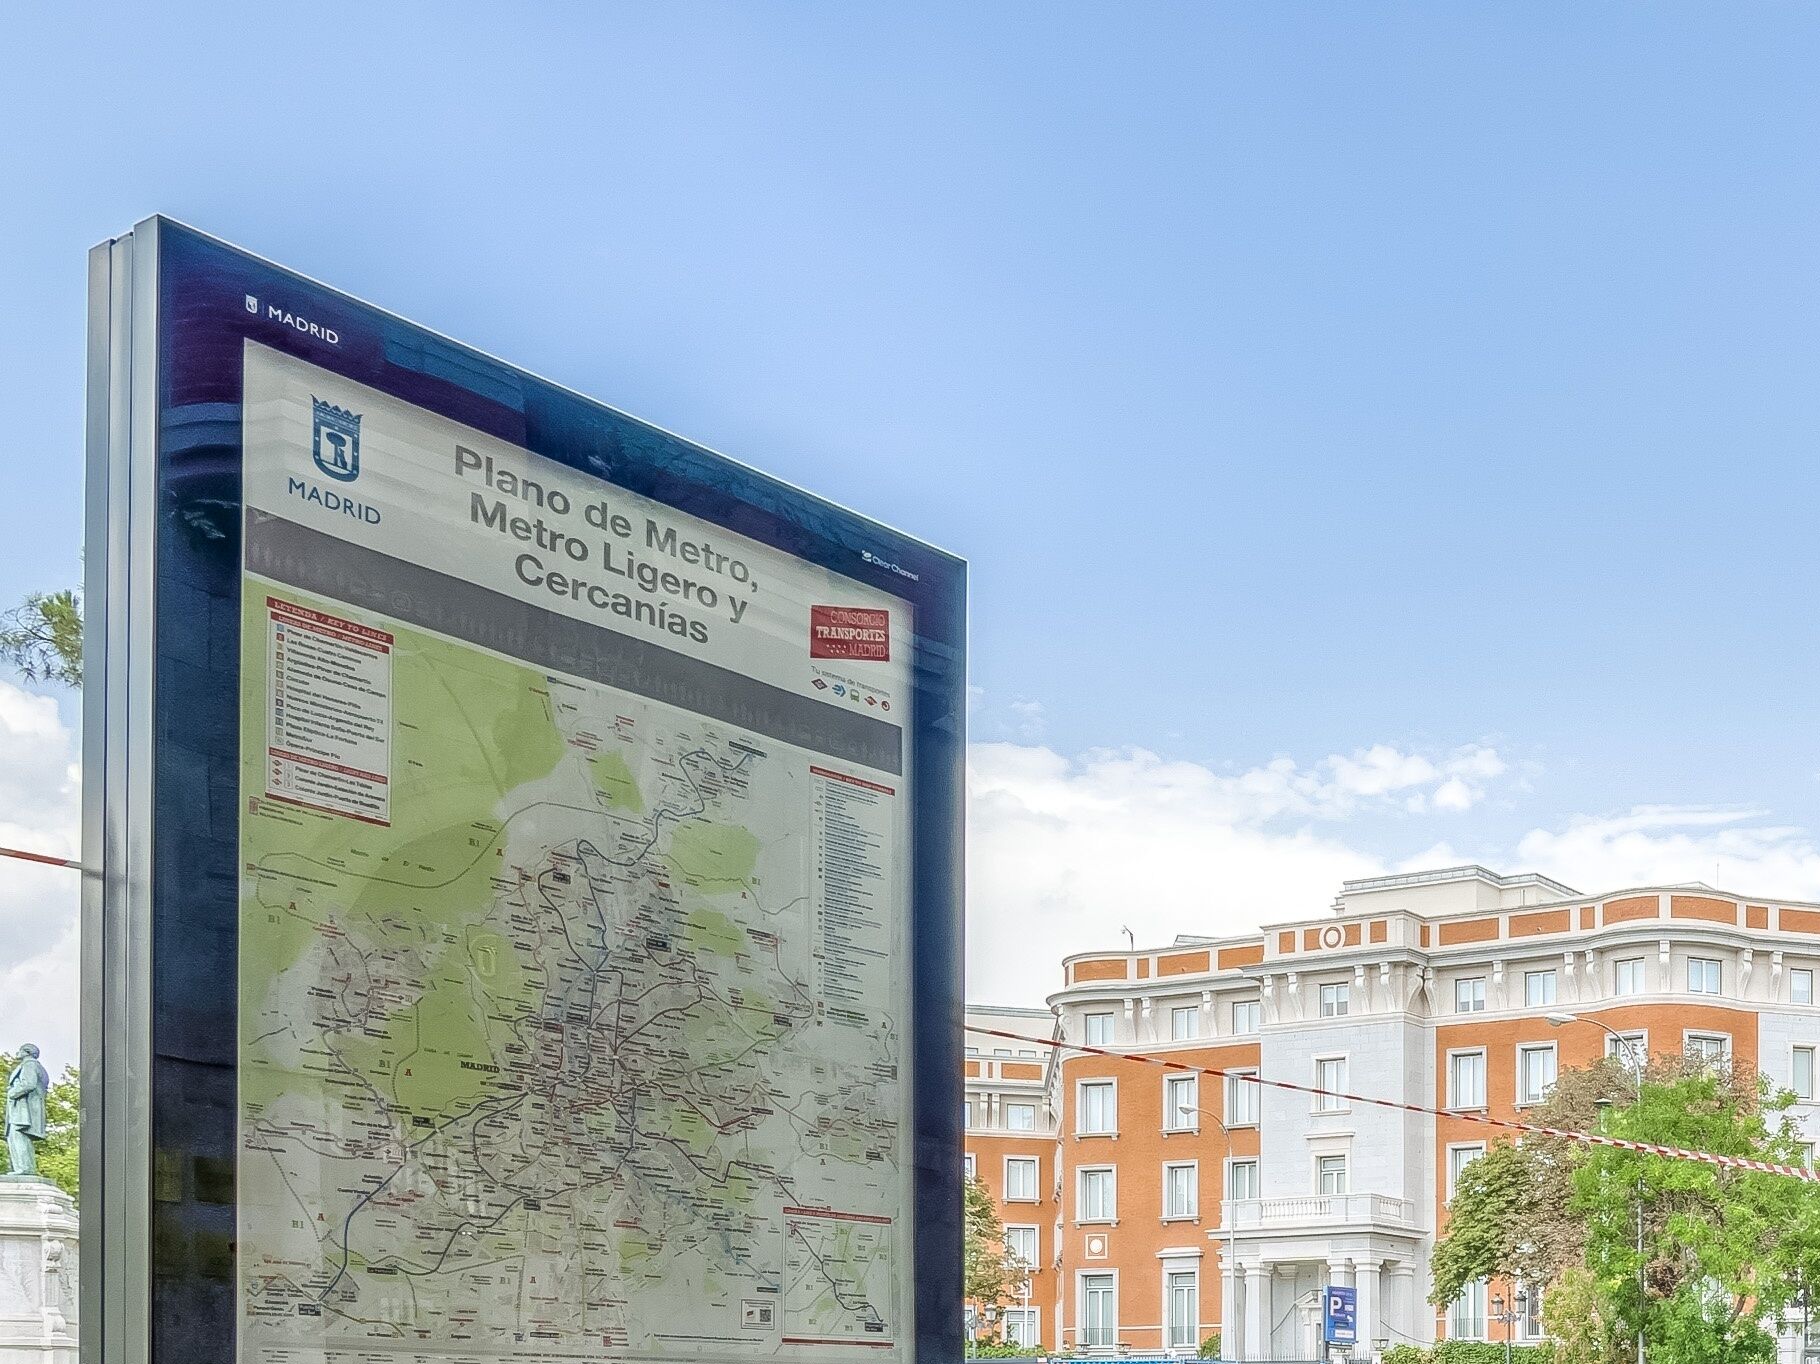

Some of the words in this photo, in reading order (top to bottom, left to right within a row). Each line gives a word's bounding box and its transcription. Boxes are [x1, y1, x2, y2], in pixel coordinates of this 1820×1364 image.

[268, 305, 339, 344] MADRID
[288, 477, 381, 525] MADRID
[455, 444, 571, 515] Plano
[584, 501, 632, 539] de
[646, 518, 758, 593] Metro,
[470, 492, 589, 562] Metro
[603, 541, 718, 608] Ligero
[729, 594, 748, 624] y
[872, 555, 892, 570] Clear
[891, 563, 919, 582] Channel
[515, 553, 709, 644] Cercanías
[831, 611, 886, 626] CONSORCIO
[816, 626, 886, 642] TRANSPORTES
[849, 644, 886, 658] MADRID
[811, 666, 821, 675] Tu
[460, 1061, 500, 1074] MADRID
[1330, 1296, 1342, 1316] P
